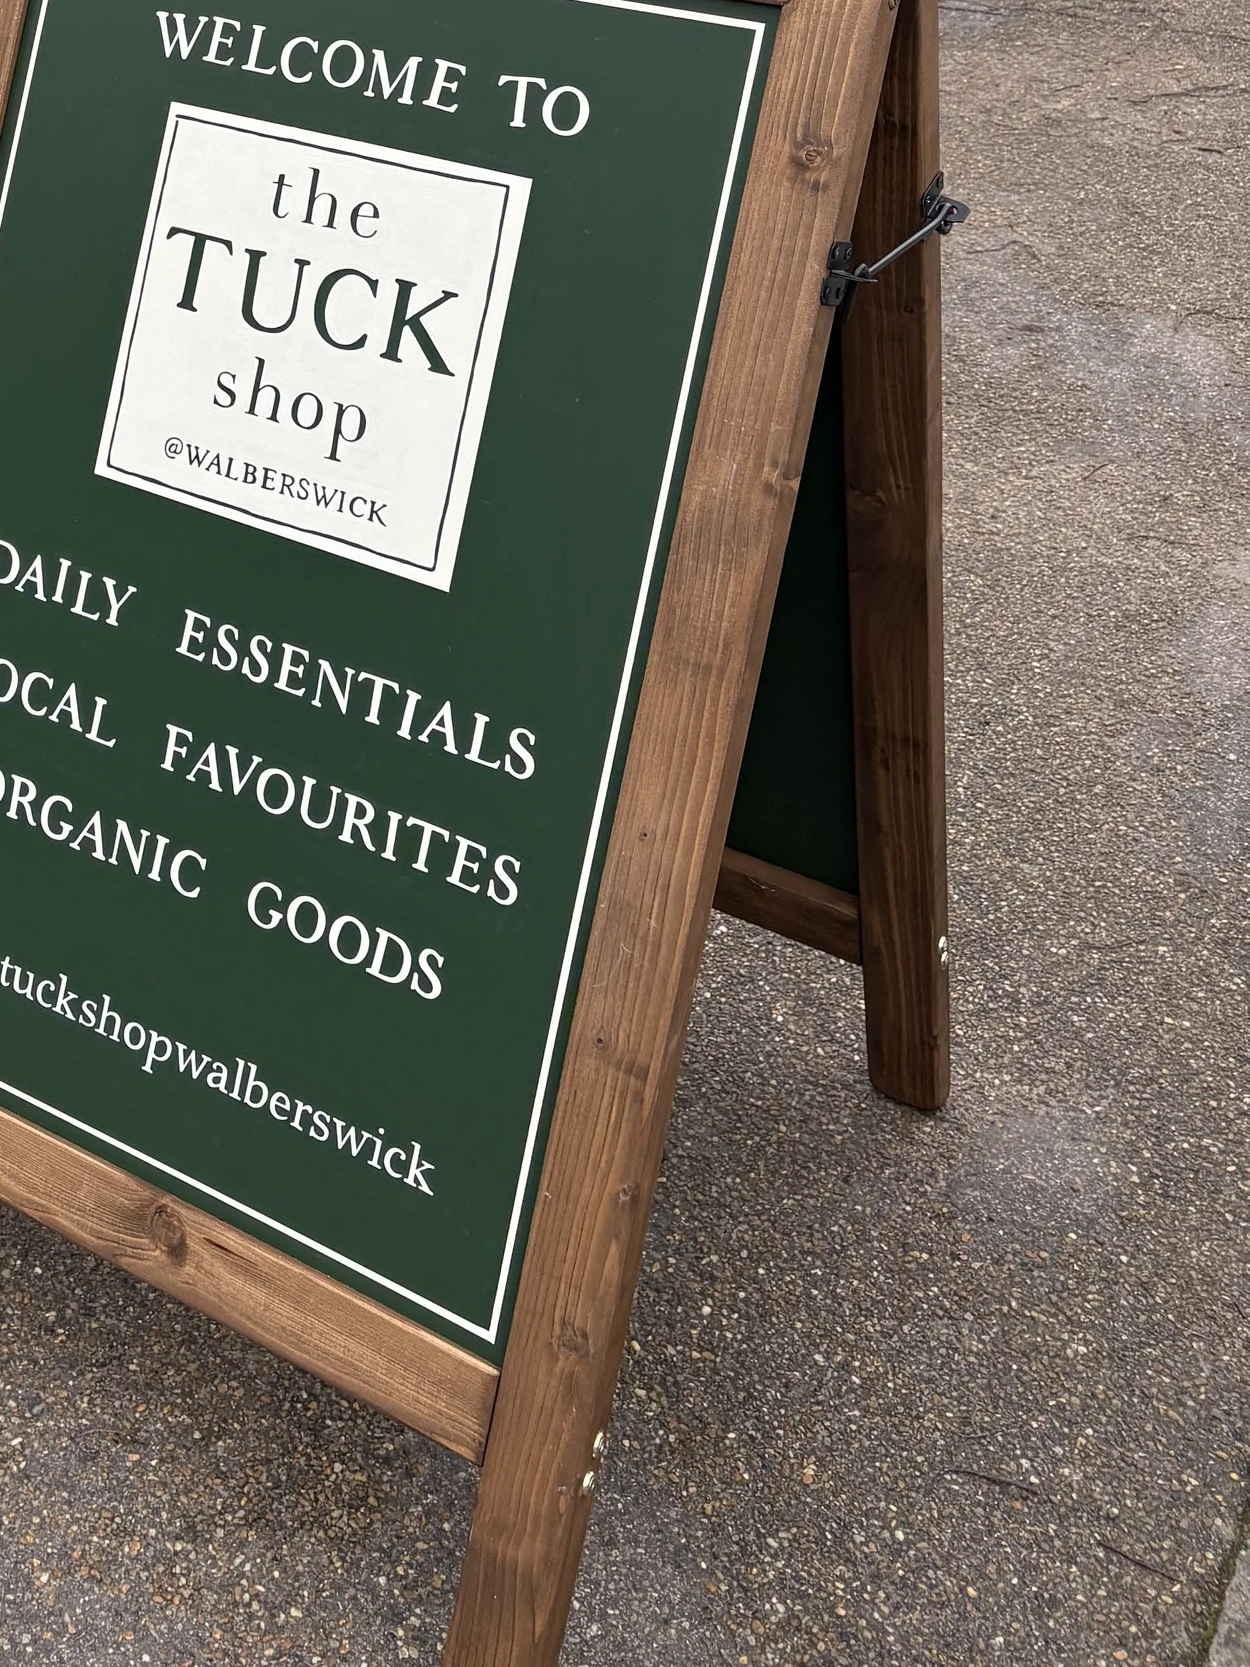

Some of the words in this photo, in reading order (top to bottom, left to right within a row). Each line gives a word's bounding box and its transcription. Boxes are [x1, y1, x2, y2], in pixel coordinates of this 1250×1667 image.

[156, 11, 466, 112] WELCOME
[498, 75, 589, 136] TO
[272, 167, 380, 239] the
[166, 226, 459, 378] TUCK
[213, 356, 367, 463] shop
[164, 436, 388, 528] @WALBERSWICK
[175, 609, 535, 779] ESSENTIALS
[161, 724, 520, 905] FAVOURITES
[248, 882, 444, 999] GOODS
